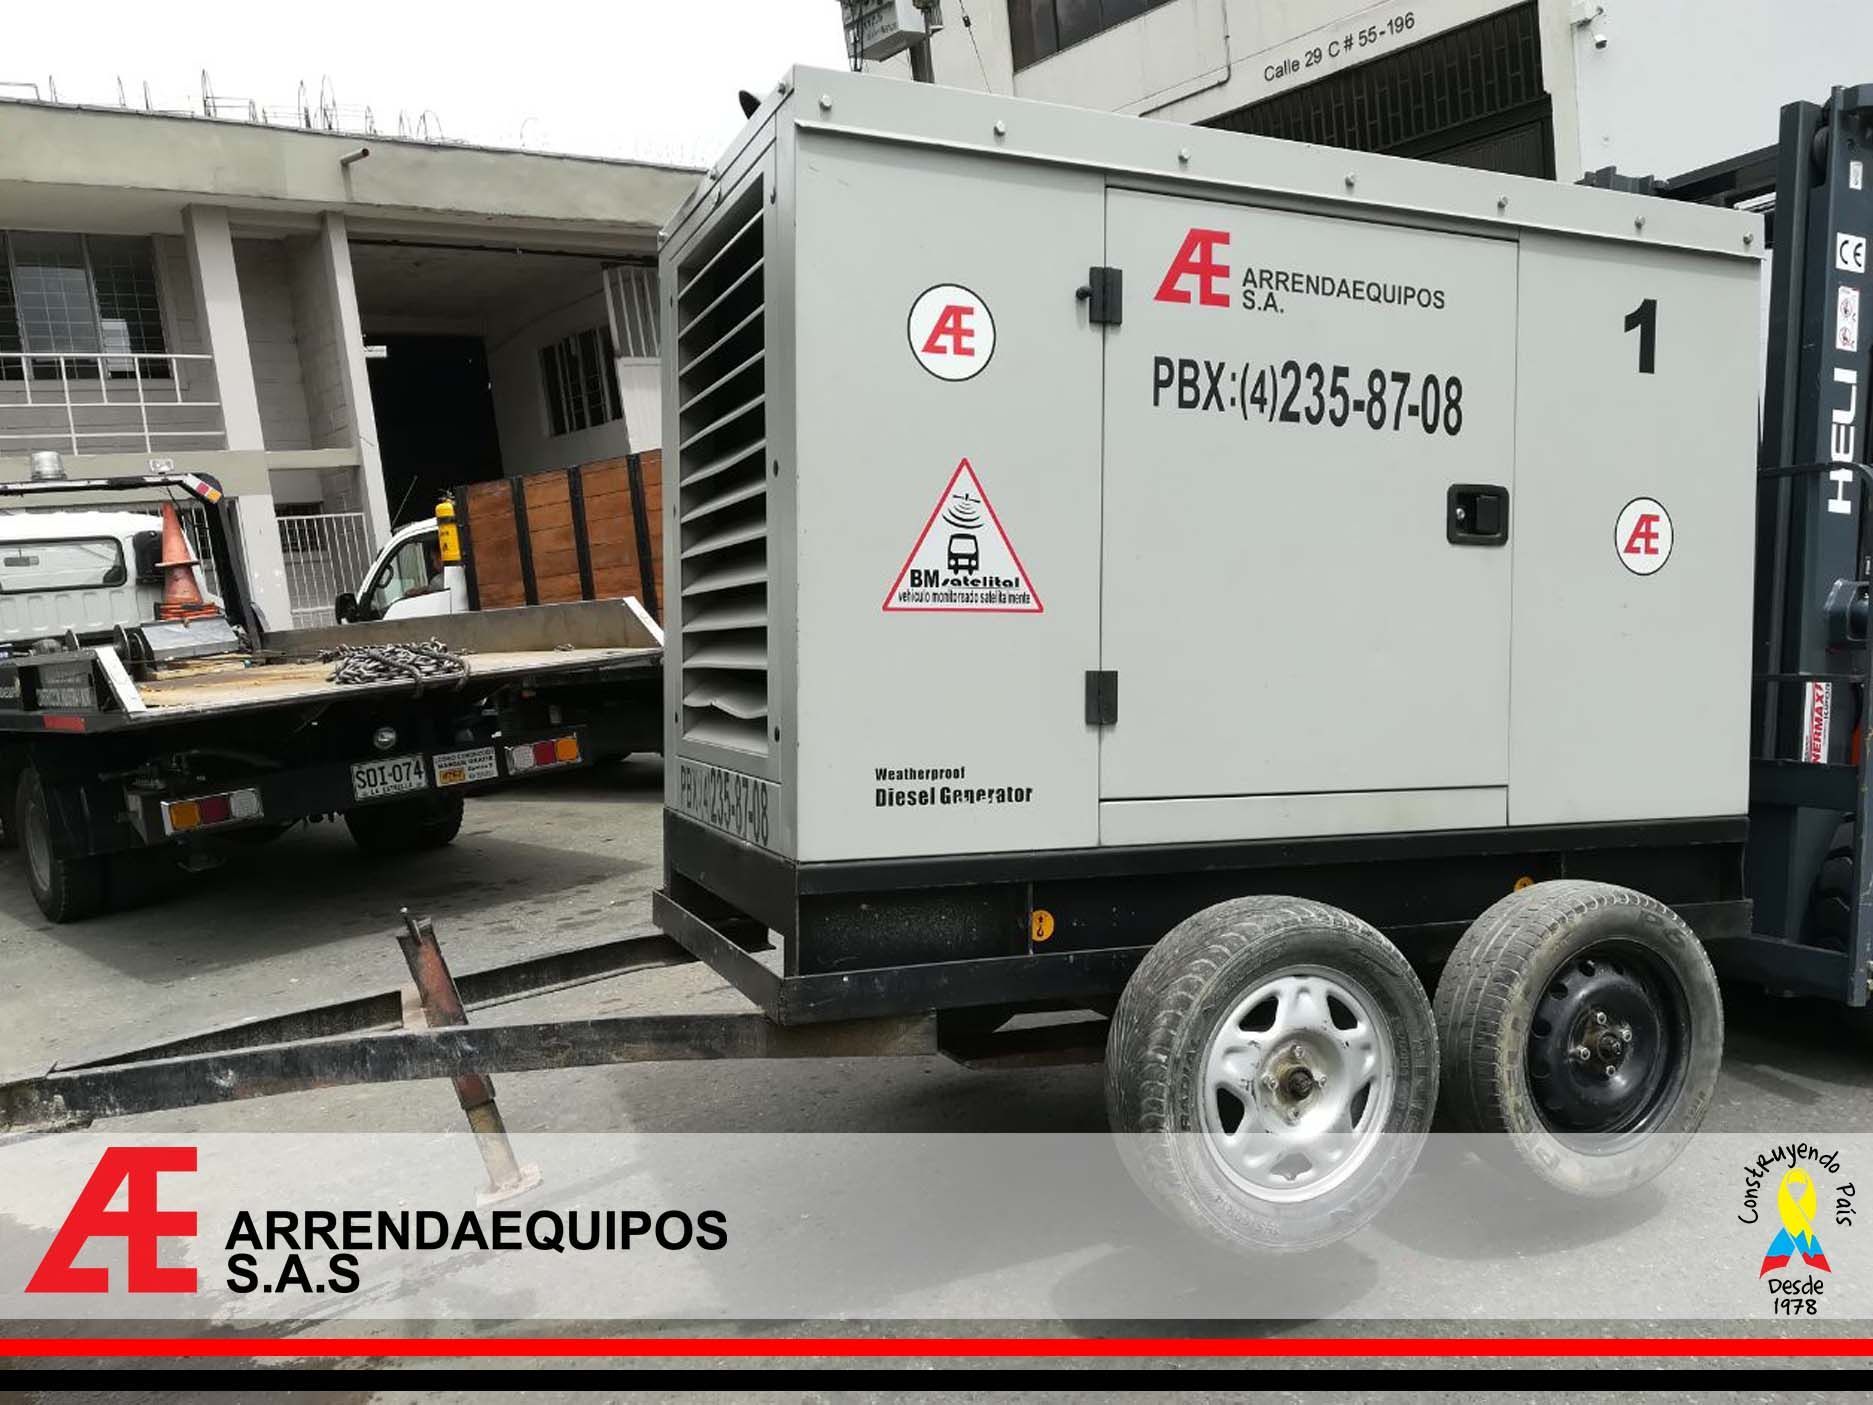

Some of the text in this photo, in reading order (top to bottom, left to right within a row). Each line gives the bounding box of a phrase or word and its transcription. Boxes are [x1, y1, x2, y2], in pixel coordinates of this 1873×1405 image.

[1264, 12, 1415, 81] Calle 29 C # 55-196
[1242, 267, 1445, 309] ARRENDAEQUIPOS
[1242, 291, 1285, 313] S.A.
[1624, 298, 1657, 374] 1
[1828, 368, 1857, 514] HELI
[875, 767, 965, 781] Weatherproof
[875, 786, 1033, 807] Diesel Generator
